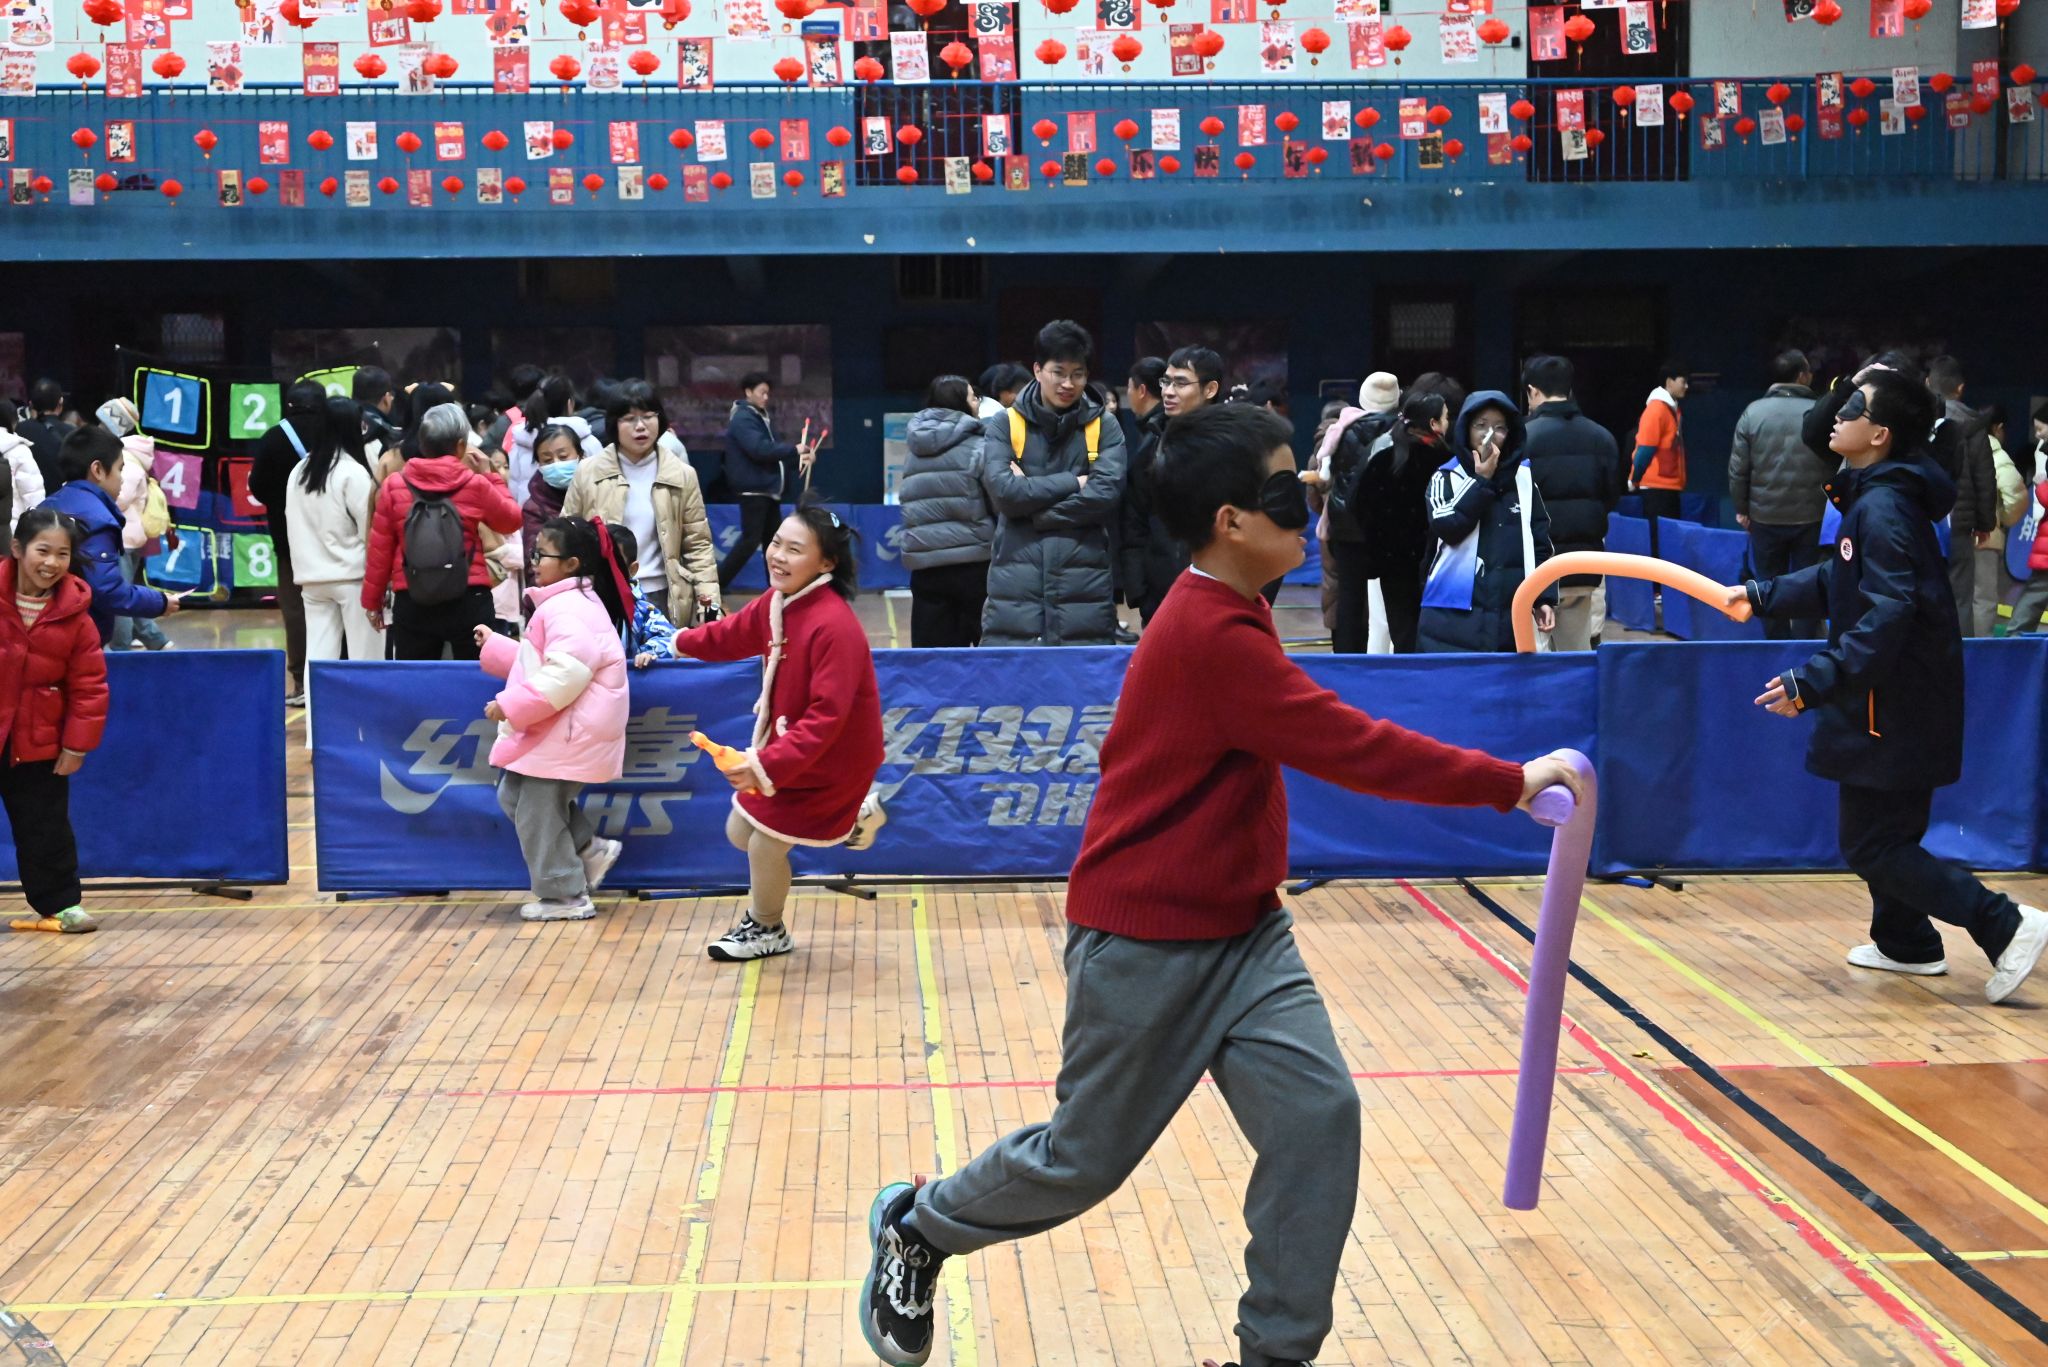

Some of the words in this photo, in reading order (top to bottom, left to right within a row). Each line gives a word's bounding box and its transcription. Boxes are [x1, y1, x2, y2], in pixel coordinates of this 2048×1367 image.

[163, 387, 182, 424] 1
[242, 393, 268, 430] 2
[160, 461, 187, 499] 4
[162, 540, 187, 573] 7
[247, 542, 273, 579] 8
[380, 706, 700, 814] 红喜
[582, 791, 692, 836] HS
[980, 782, 1095, 826] DH
